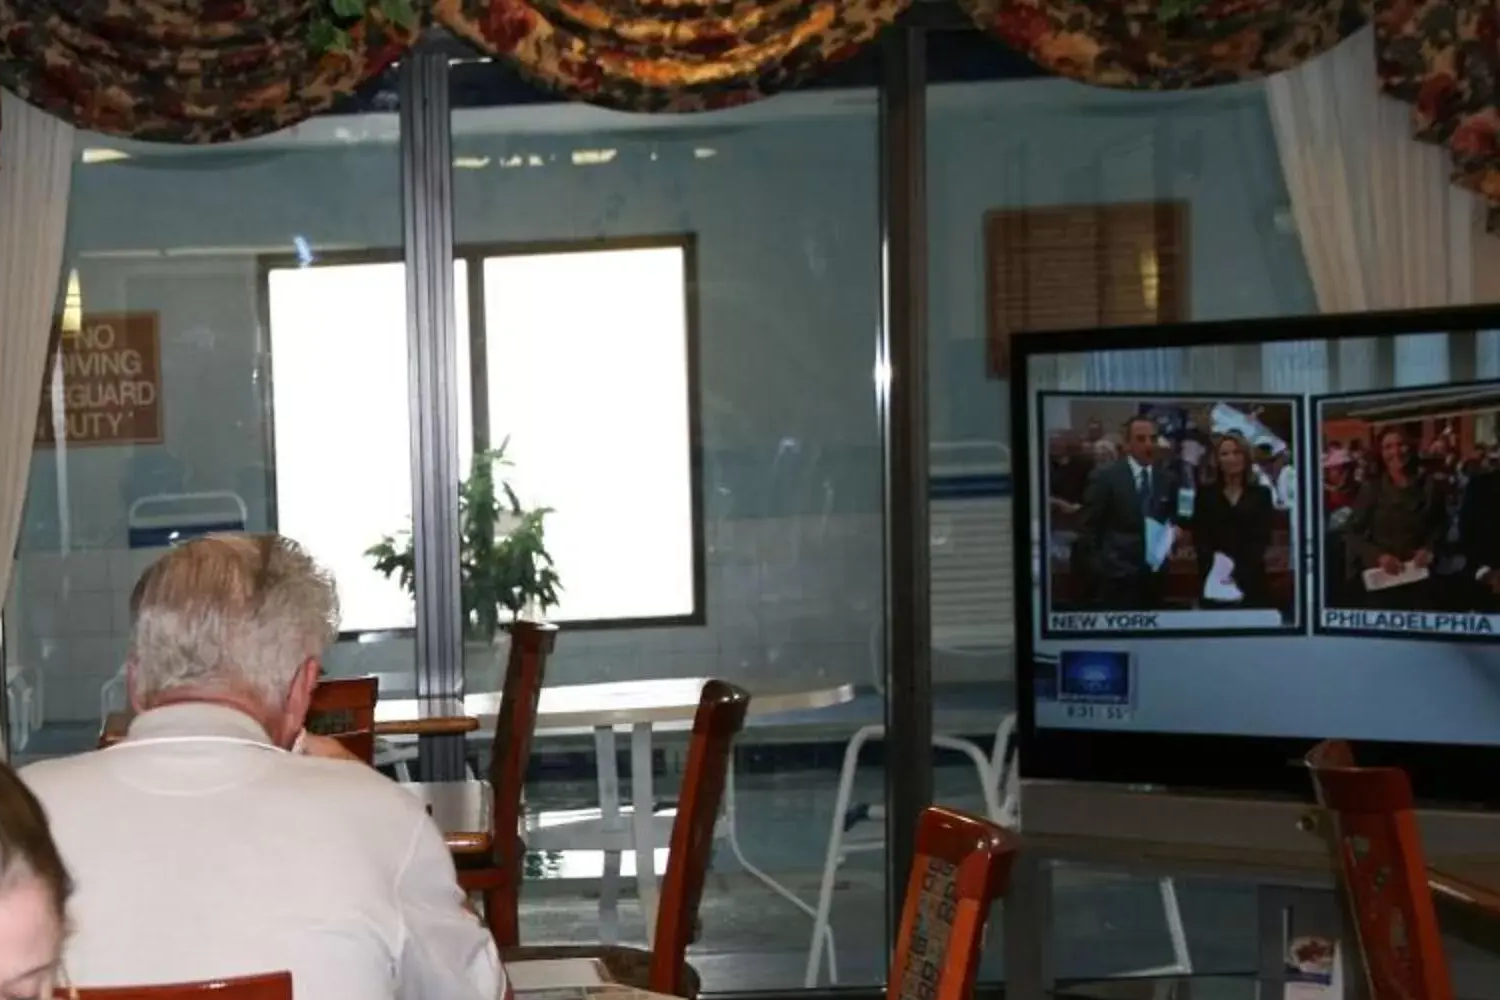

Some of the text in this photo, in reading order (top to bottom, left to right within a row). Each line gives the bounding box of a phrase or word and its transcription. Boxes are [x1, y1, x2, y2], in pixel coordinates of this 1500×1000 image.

[74, 324, 115, 350] NO
[1051, 613, 1160, 630] NEW YORK
[1324, 610, 1493, 633] PHILADELPHIA
